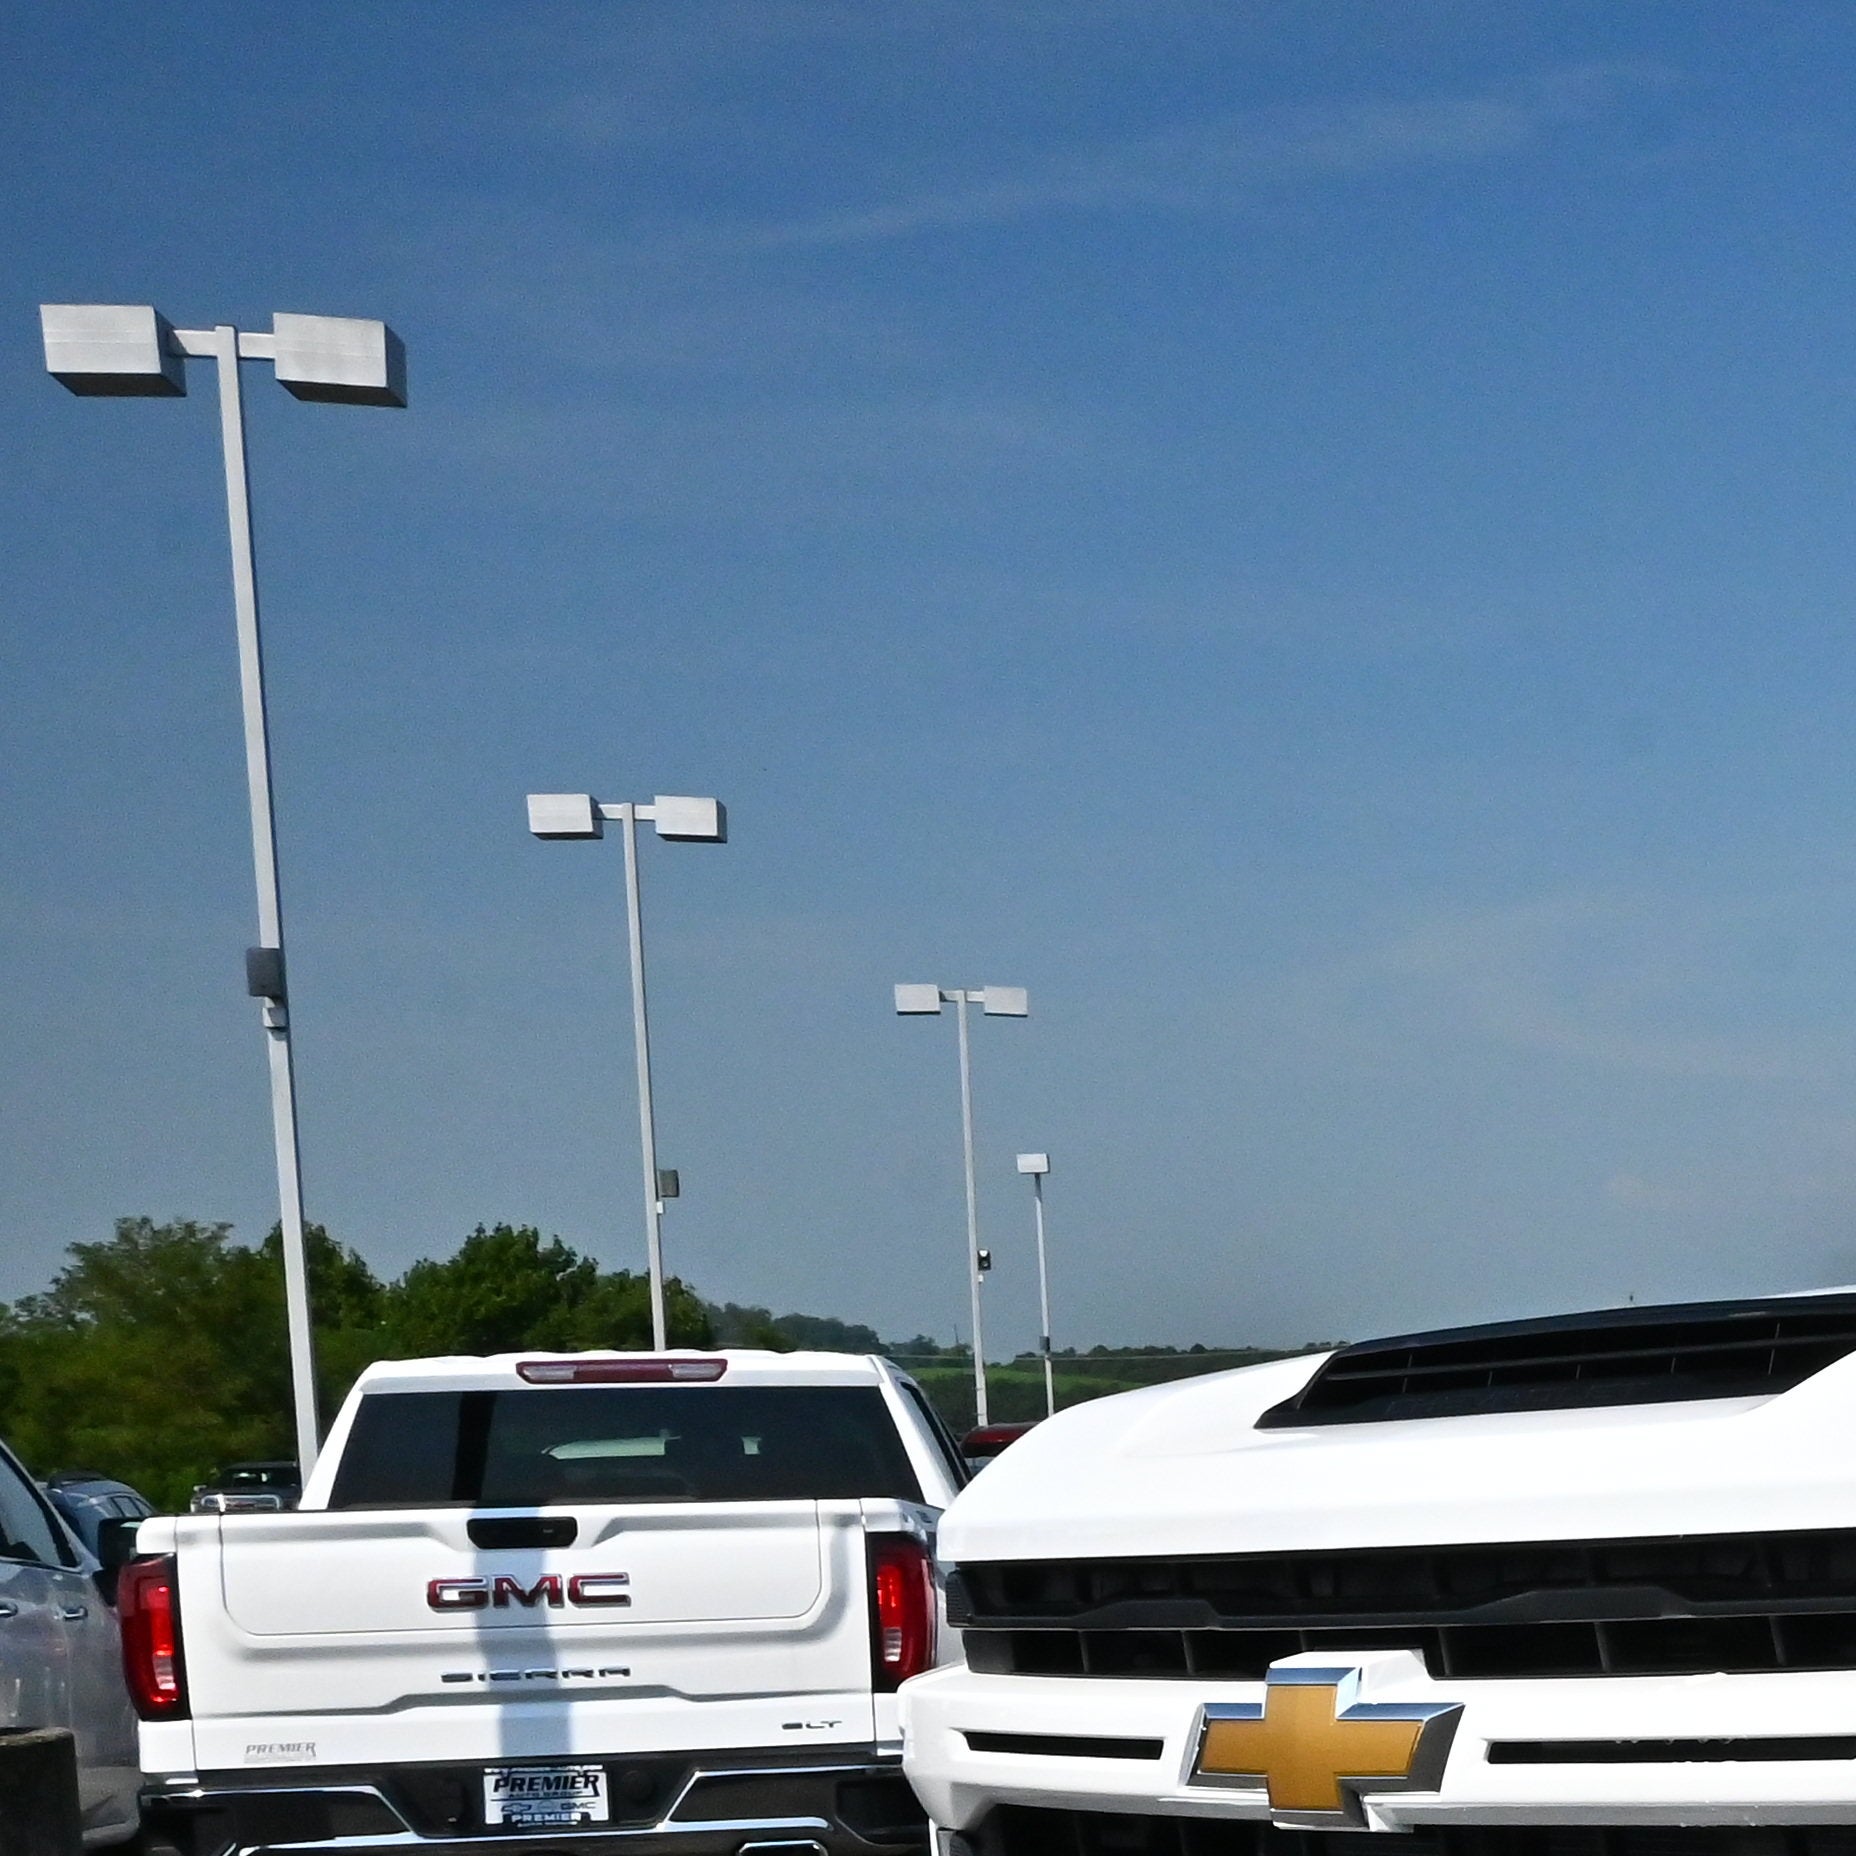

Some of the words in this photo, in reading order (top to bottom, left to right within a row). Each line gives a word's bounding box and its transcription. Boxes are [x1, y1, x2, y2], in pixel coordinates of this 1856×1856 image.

[426, 1571, 633, 1614] GMC
[440, 1666, 632, 1683] SIERRA
[245, 1742, 317, 1758] PREMIER
[493, 1774, 601, 1798] PREMIER
[560, 1802, 596, 1811] GMC
[511, 1813, 582, 1823] PREMIER
